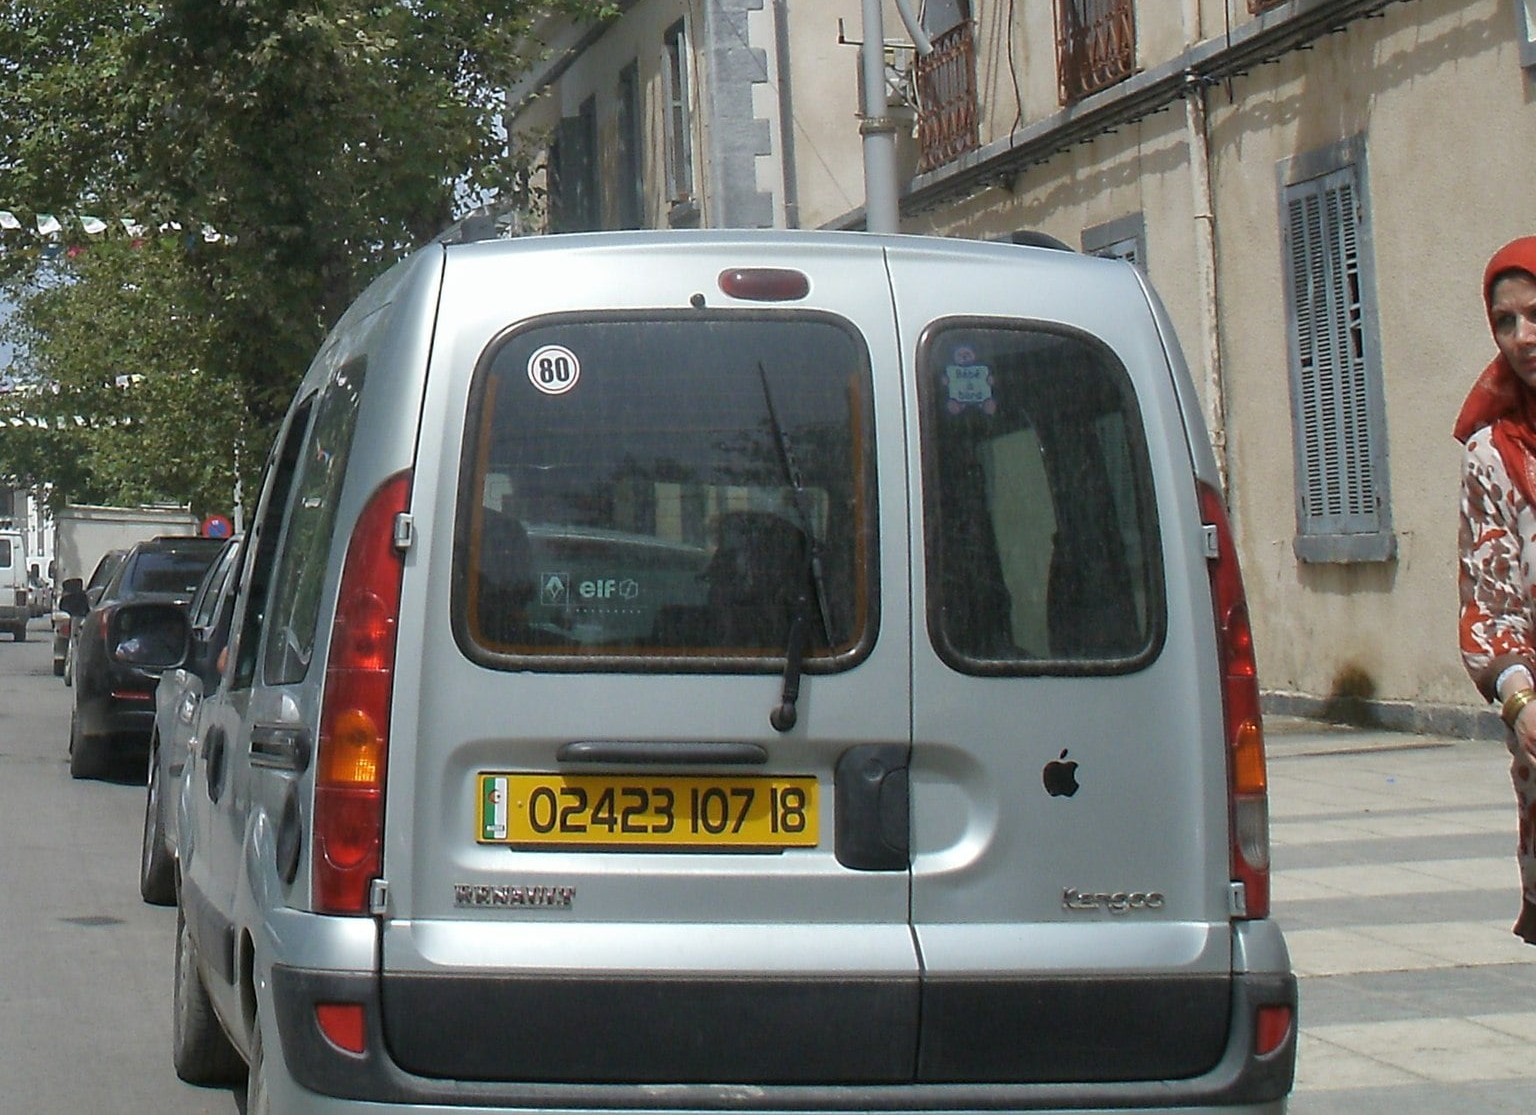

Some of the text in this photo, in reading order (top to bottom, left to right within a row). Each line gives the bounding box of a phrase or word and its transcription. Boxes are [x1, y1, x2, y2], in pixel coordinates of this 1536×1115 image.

[539, 357, 570, 383] 80
[579, 580, 616, 598] elf
[529, 787, 807, 834] 02423 107 18
